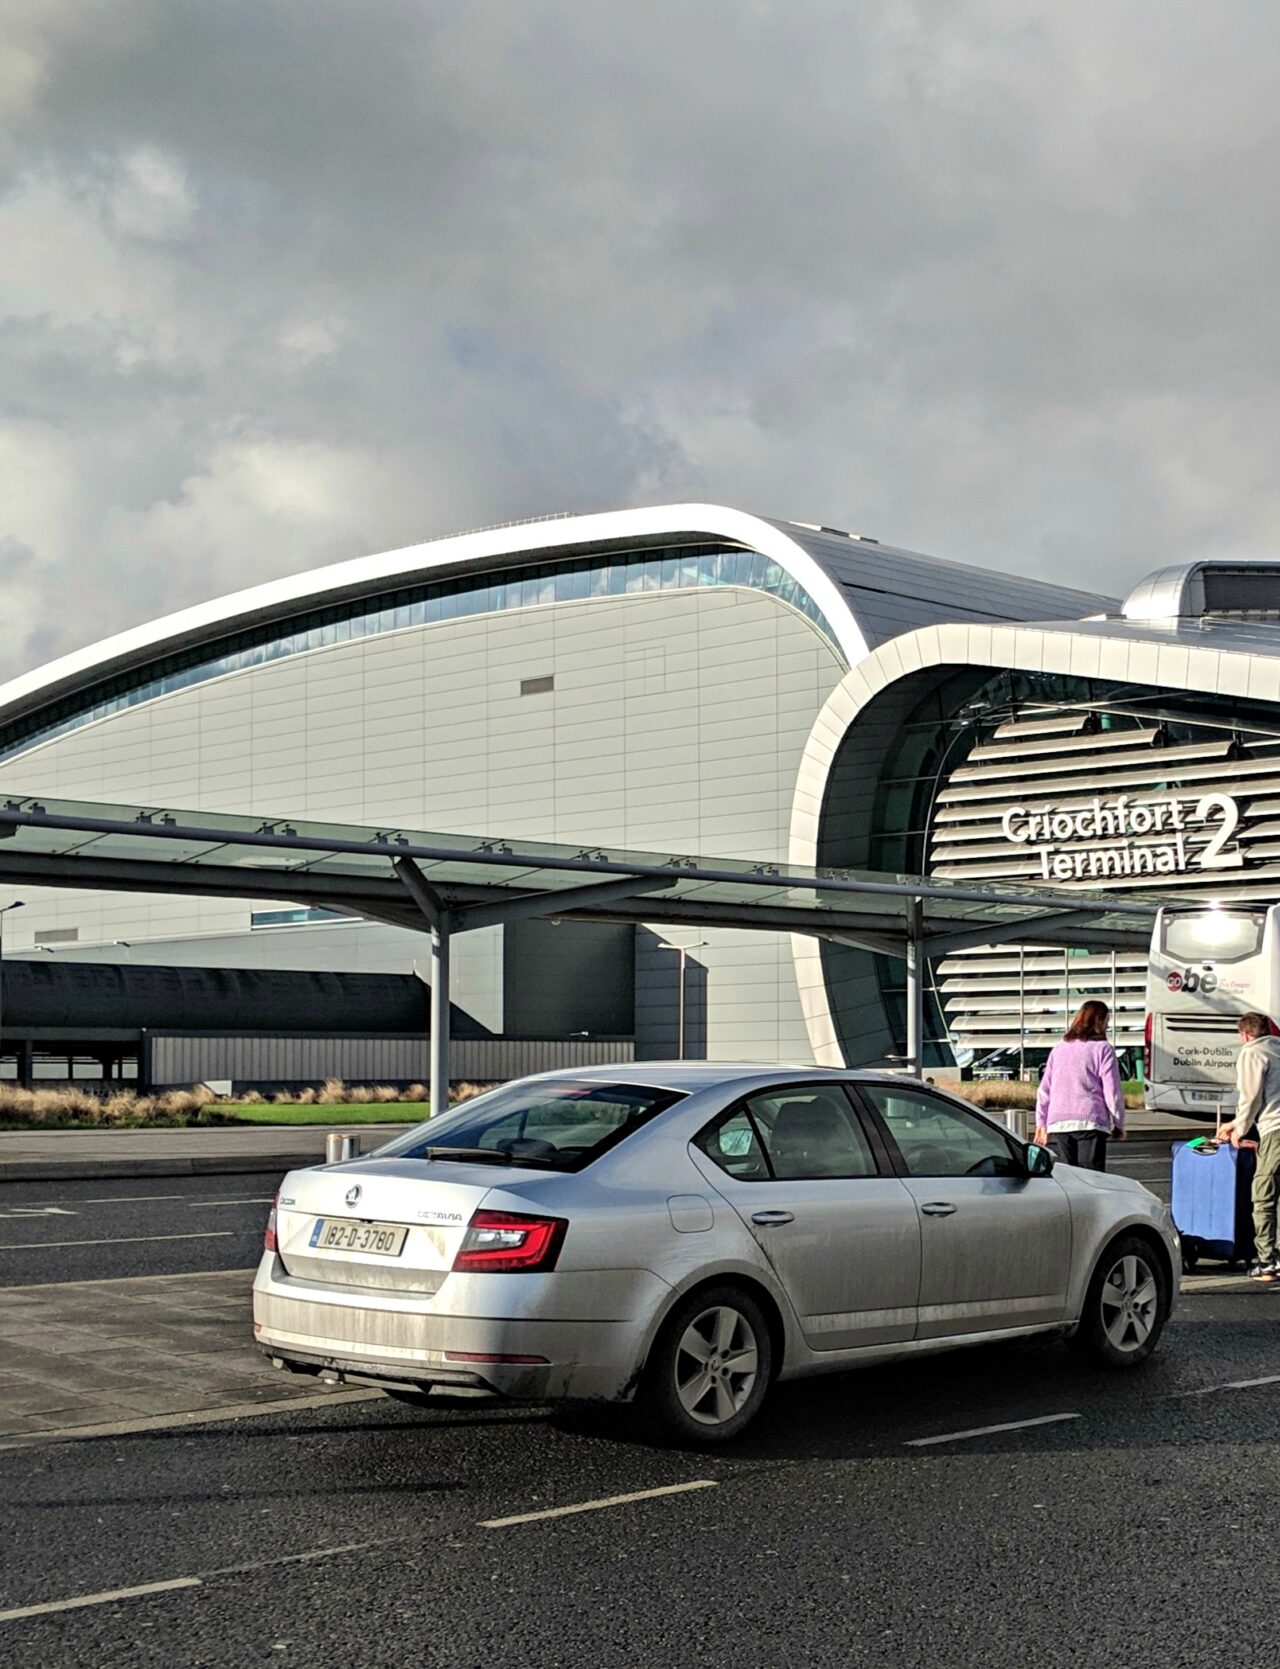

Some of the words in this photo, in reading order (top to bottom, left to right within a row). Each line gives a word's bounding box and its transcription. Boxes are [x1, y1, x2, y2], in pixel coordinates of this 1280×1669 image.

[1195, 792, 1243, 869] 2
[1032, 832, 1187, 880] Terminal
[1173, 1057, 1202, 1067] Dublin
[1177, 1046, 1233, 1057] Cork-Dublin
[323, 1225, 396, 1251] 182-D-3780
